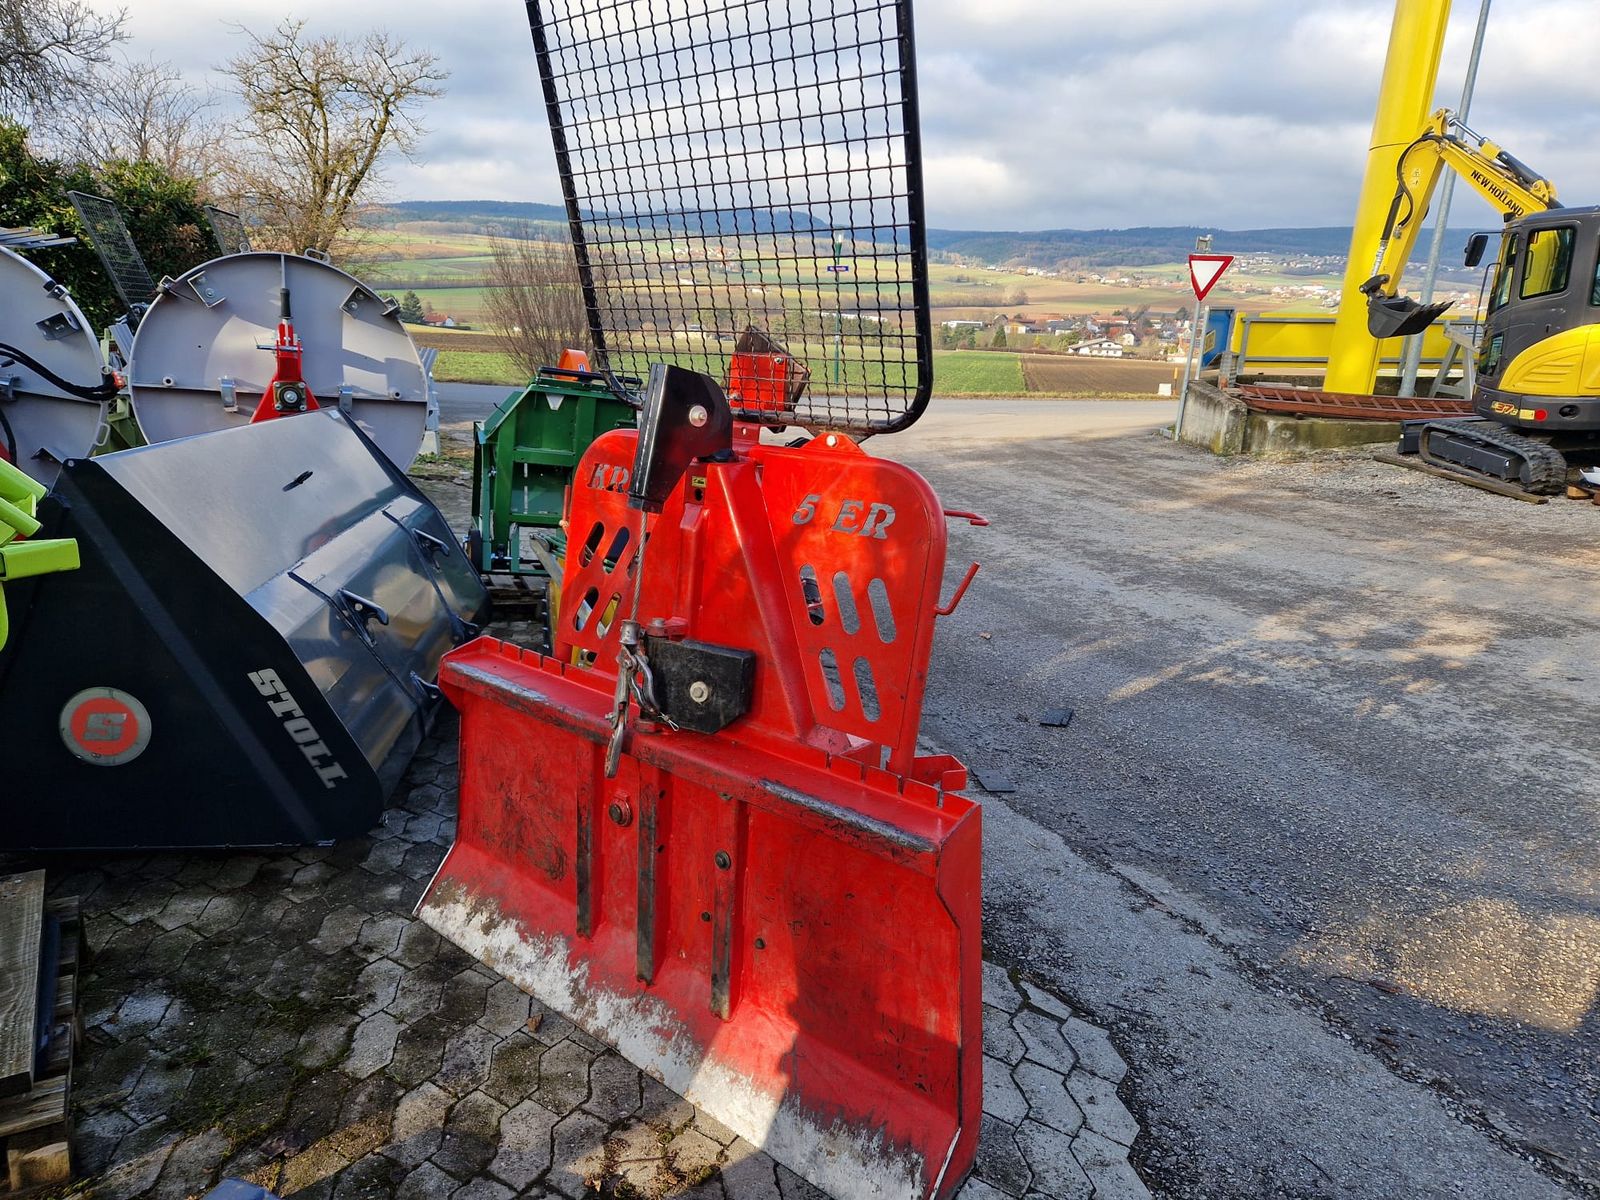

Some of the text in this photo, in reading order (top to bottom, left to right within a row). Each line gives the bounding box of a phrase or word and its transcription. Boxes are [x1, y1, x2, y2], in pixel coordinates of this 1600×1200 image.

[1471, 170, 1525, 217] NEW HOLLAND
[791, 493, 896, 539] 5 ER
[82, 712, 128, 742] S
[247, 668, 349, 790] STOLL
